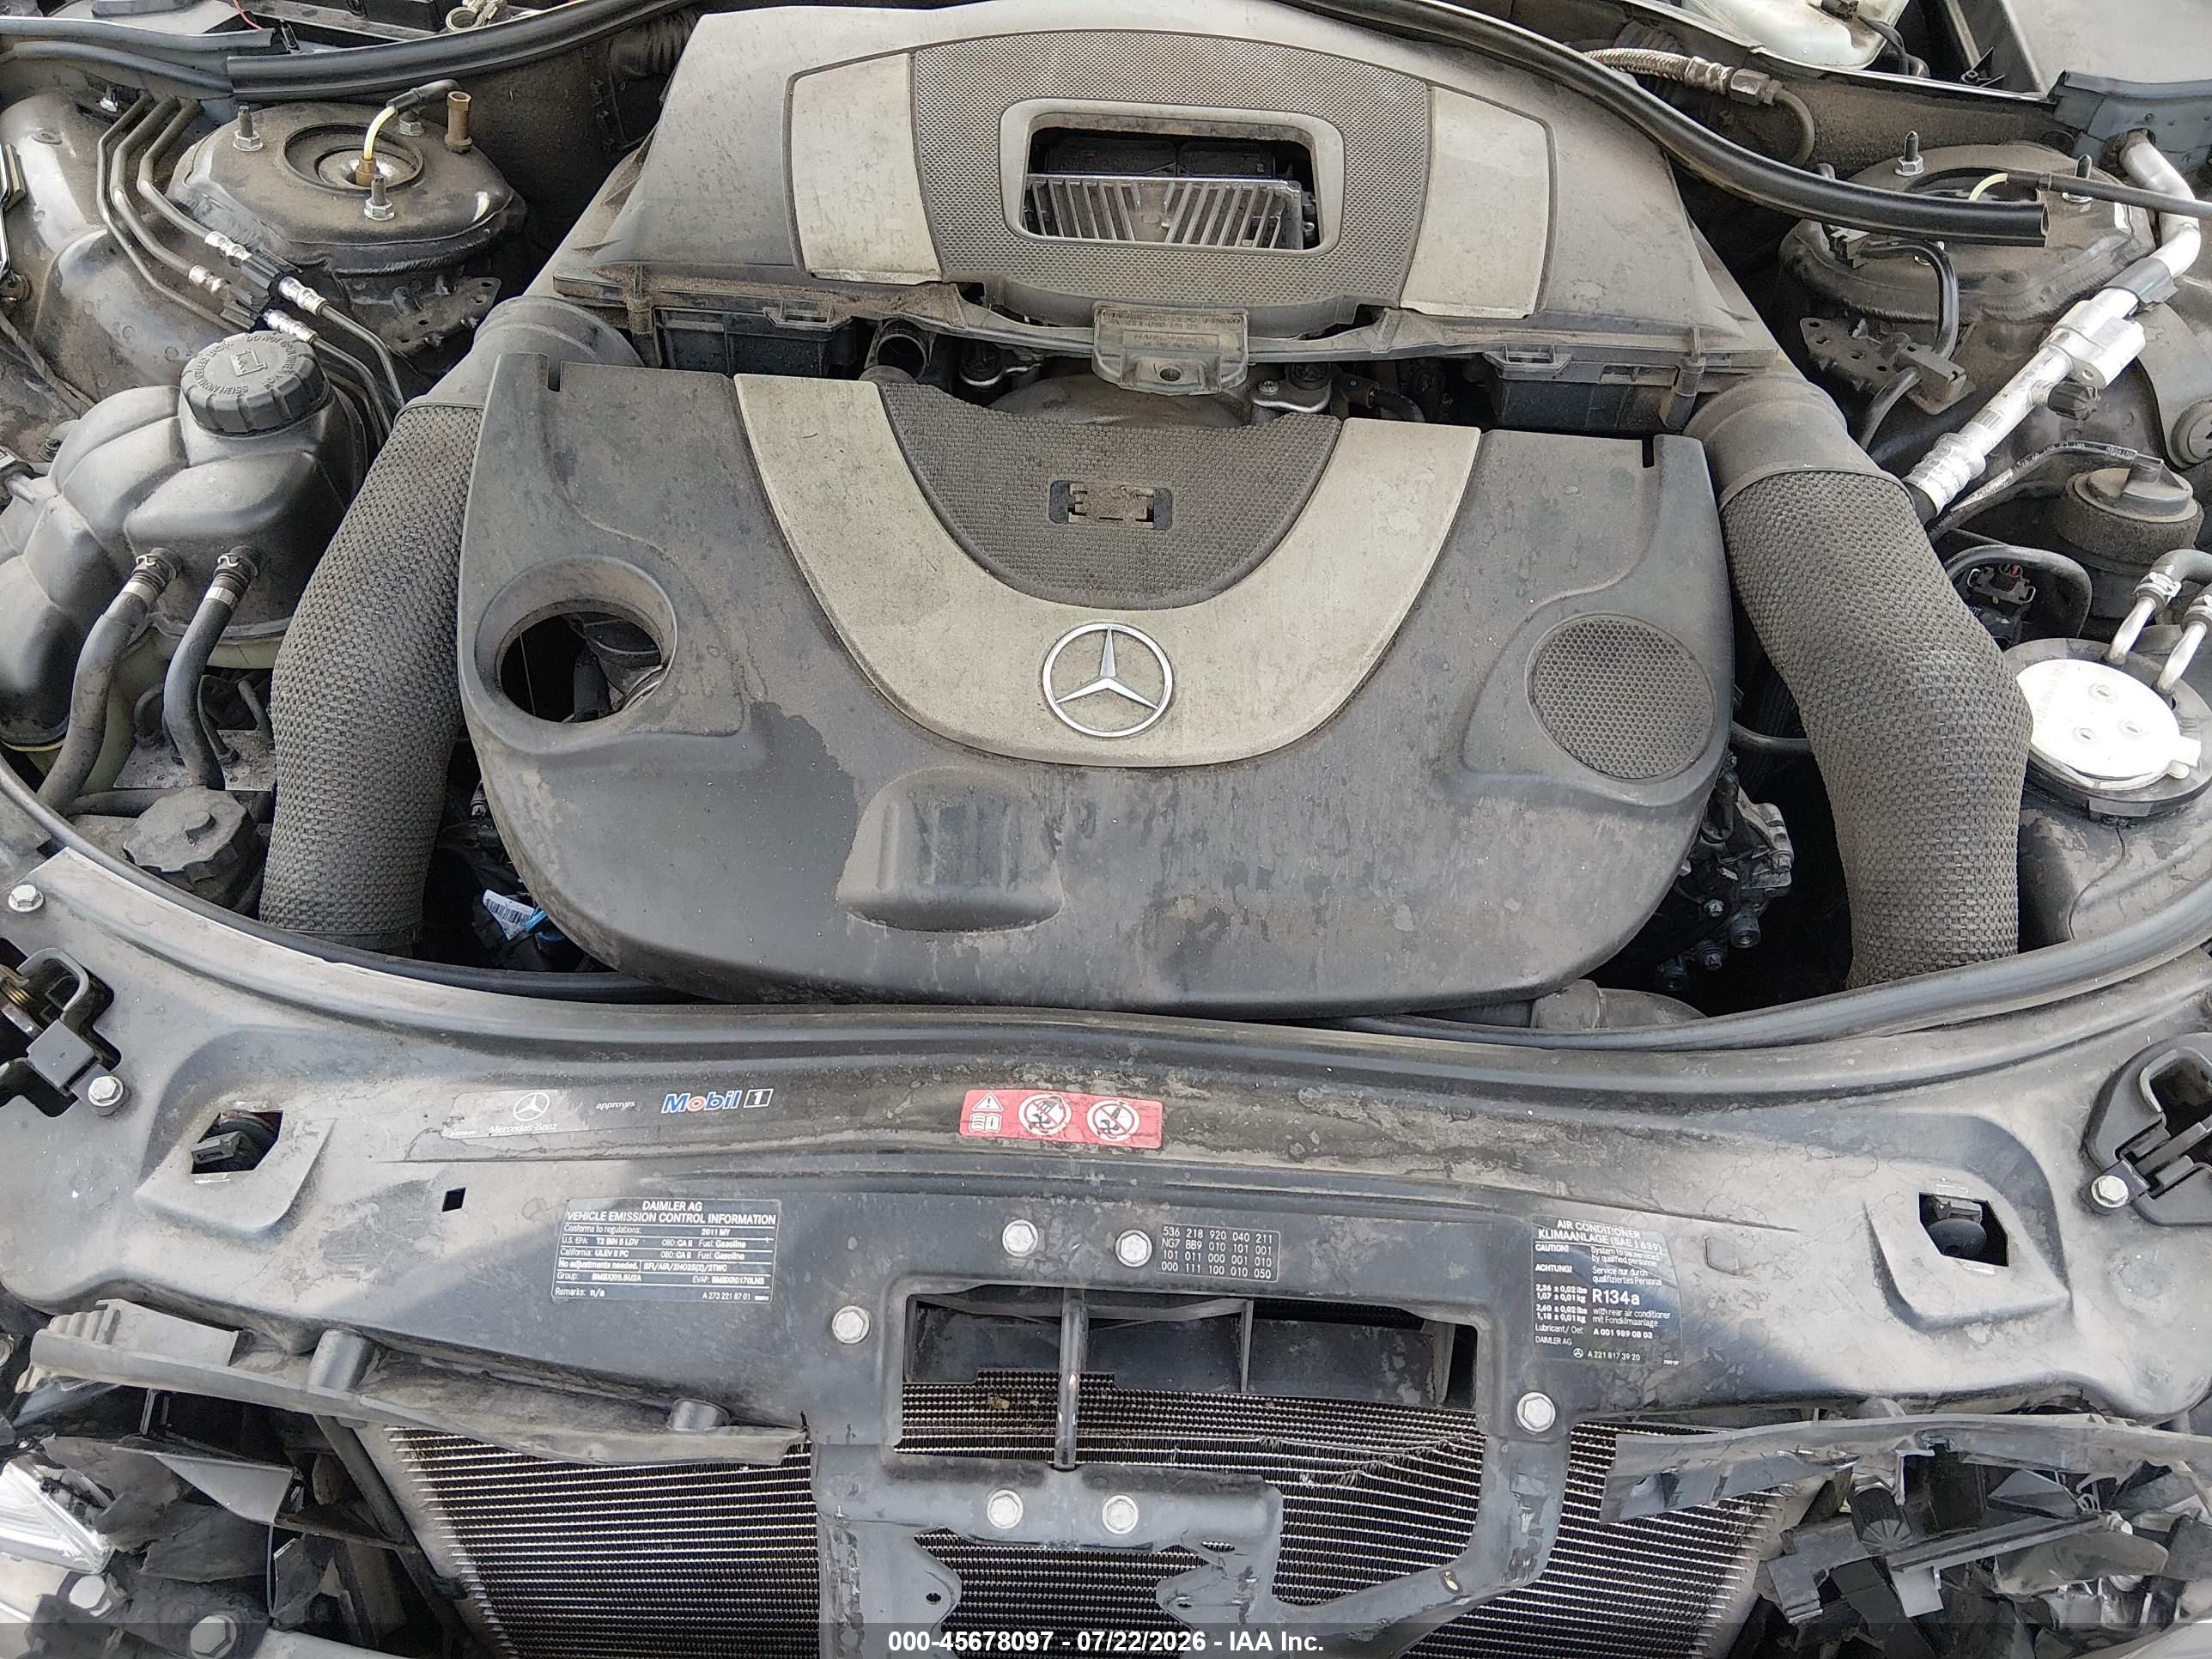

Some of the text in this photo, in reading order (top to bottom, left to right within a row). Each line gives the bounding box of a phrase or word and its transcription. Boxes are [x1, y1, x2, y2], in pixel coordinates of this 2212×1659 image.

[219, 385, 249, 395] HEISS
[595, 1099, 635, 1110] approves
[661, 1091, 743, 1114] Mobil
[489, 1123, 558, 1134] Mercedes-Benz
[642, 1200, 702, 1212] DAIMLER AG
[567, 1211, 776, 1225] VEHICLE EMISSION CONTROL INFORMATION
[563, 1224, 594, 1233] Conforms
[604, 1226, 641, 1235] regulations:
[1557, 1219, 1642, 1239] AIR CONDITIONER
[1163, 1226, 1273, 1244] 536 218 920 040 211
[698, 1239, 714, 1248] Fuel:
[1161, 1238, 1180, 1249] NG7
[1208, 1242, 1226, 1252] 010
[1233, 1243, 1249, 1254] 101
[1255, 1245, 1272, 1255] 001
[1538, 1228, 1609, 1244] KLIMAANLAGE
[1610, 1237, 1632, 1248] (SAE
[1640, 1241, 1662, 1254] 639)
[560, 1248, 593, 1256] California:
[1535, 1244, 1570, 1253] CAUTION!
[1591, 1246, 1615, 1255] System
[1164, 1249, 1272, 1267] 101 011 000 001 010
[1591, 1254, 1600, 1263] by
[558, 1259, 568, 1267] No
[569, 1260, 611, 1269] adjustments
[1535, 1263, 1573, 1273] ACHTUNG!
[1161, 1261, 1271, 1279] 000 111 100 010 050
[1592, 1266, 1617, 1275] Service
[556, 1272, 579, 1280] Group:
[1592, 1275, 1662, 1285] qualifiziertes Personal
[555, 1287, 586, 1296] Remarks:
[590, 1288, 605, 1297] n/a
[1559, 1285, 1576, 1293] 0,02
[1537, 1291, 1552, 1300] 1,07
[1559, 1293, 1576, 1302] 0,01
[1577, 1294, 1586, 1304] kg
[1592, 1288, 1640, 1305] R134a
[1559, 1304, 1577, 1314] 0,02
[1593, 1307, 1607, 1316] with
[1624, 1309, 1632, 1317] air
[1633, 1310, 1671, 1319] conditioner
[1559, 1313, 1576, 1322] 0,01
[1577, 1314, 1586, 1323] kg
[1605, 1316, 1659, 1328] Fondklimaanlage
[1534, 1335, 1572, 1346] DAIMLER AG
